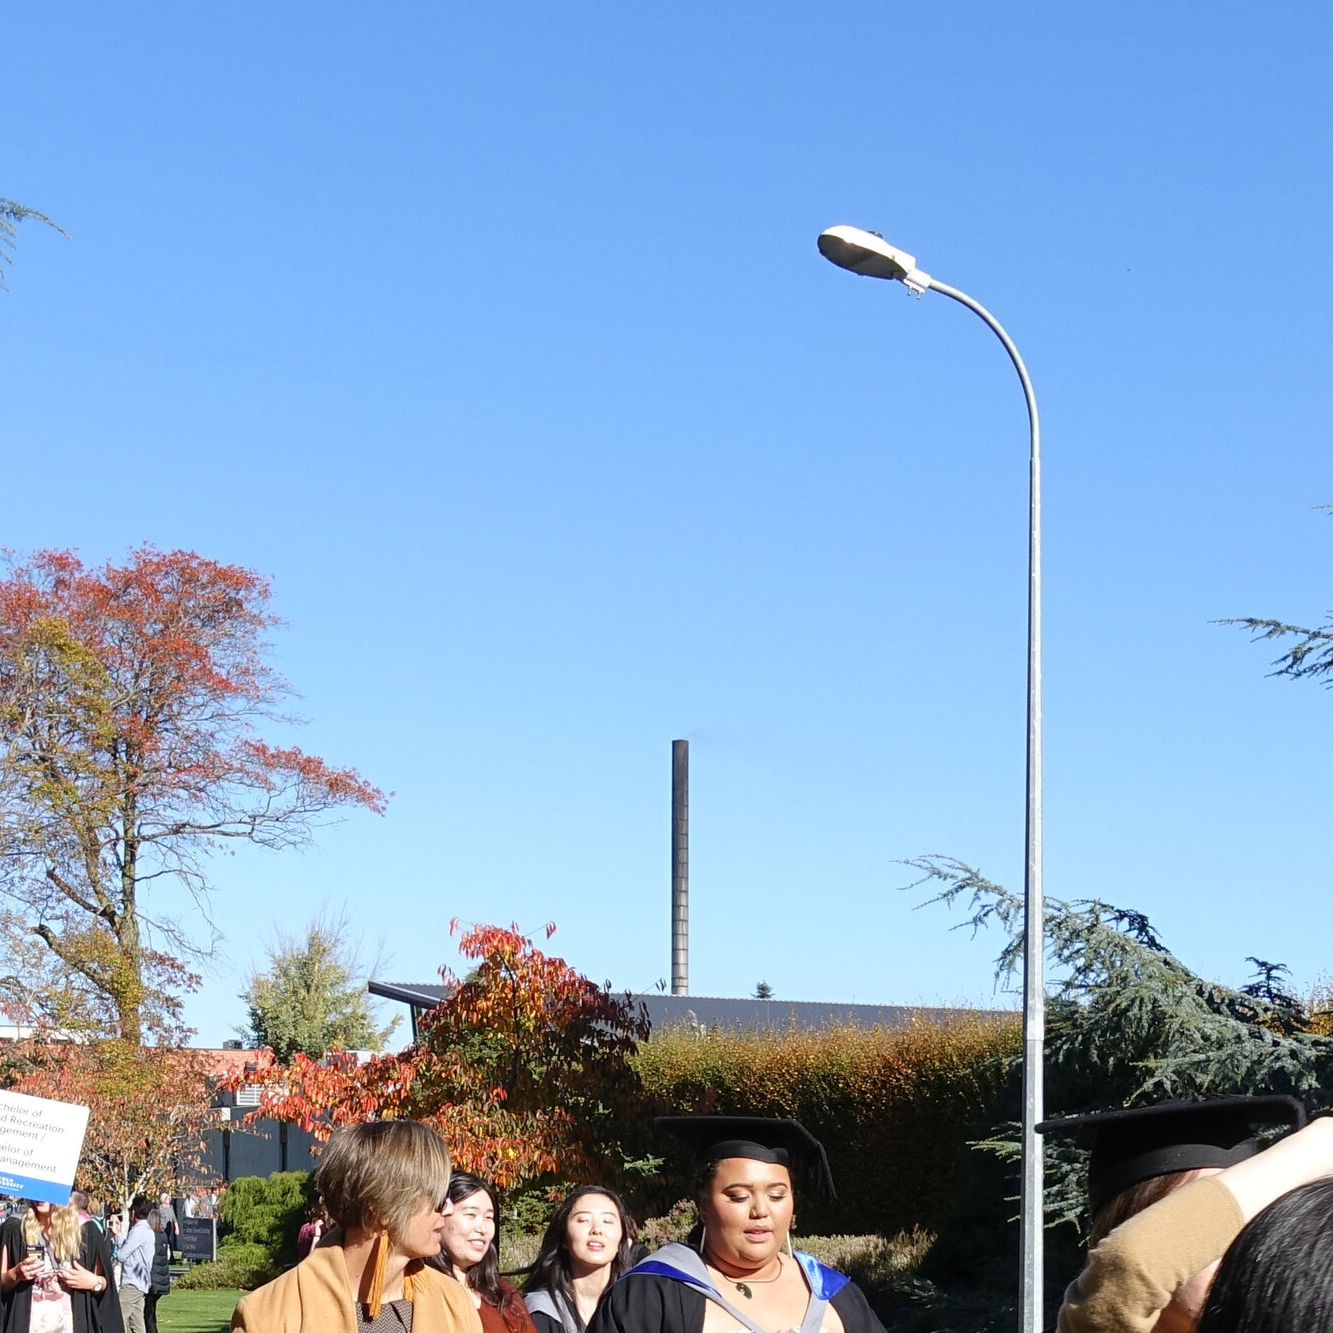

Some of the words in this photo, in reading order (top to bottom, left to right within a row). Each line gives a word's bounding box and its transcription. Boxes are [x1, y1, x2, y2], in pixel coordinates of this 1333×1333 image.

[32, 1110, 43, 1118] of
[10, 1116, 64, 1134] Recreation
[23, 1148, 35, 1157] of
